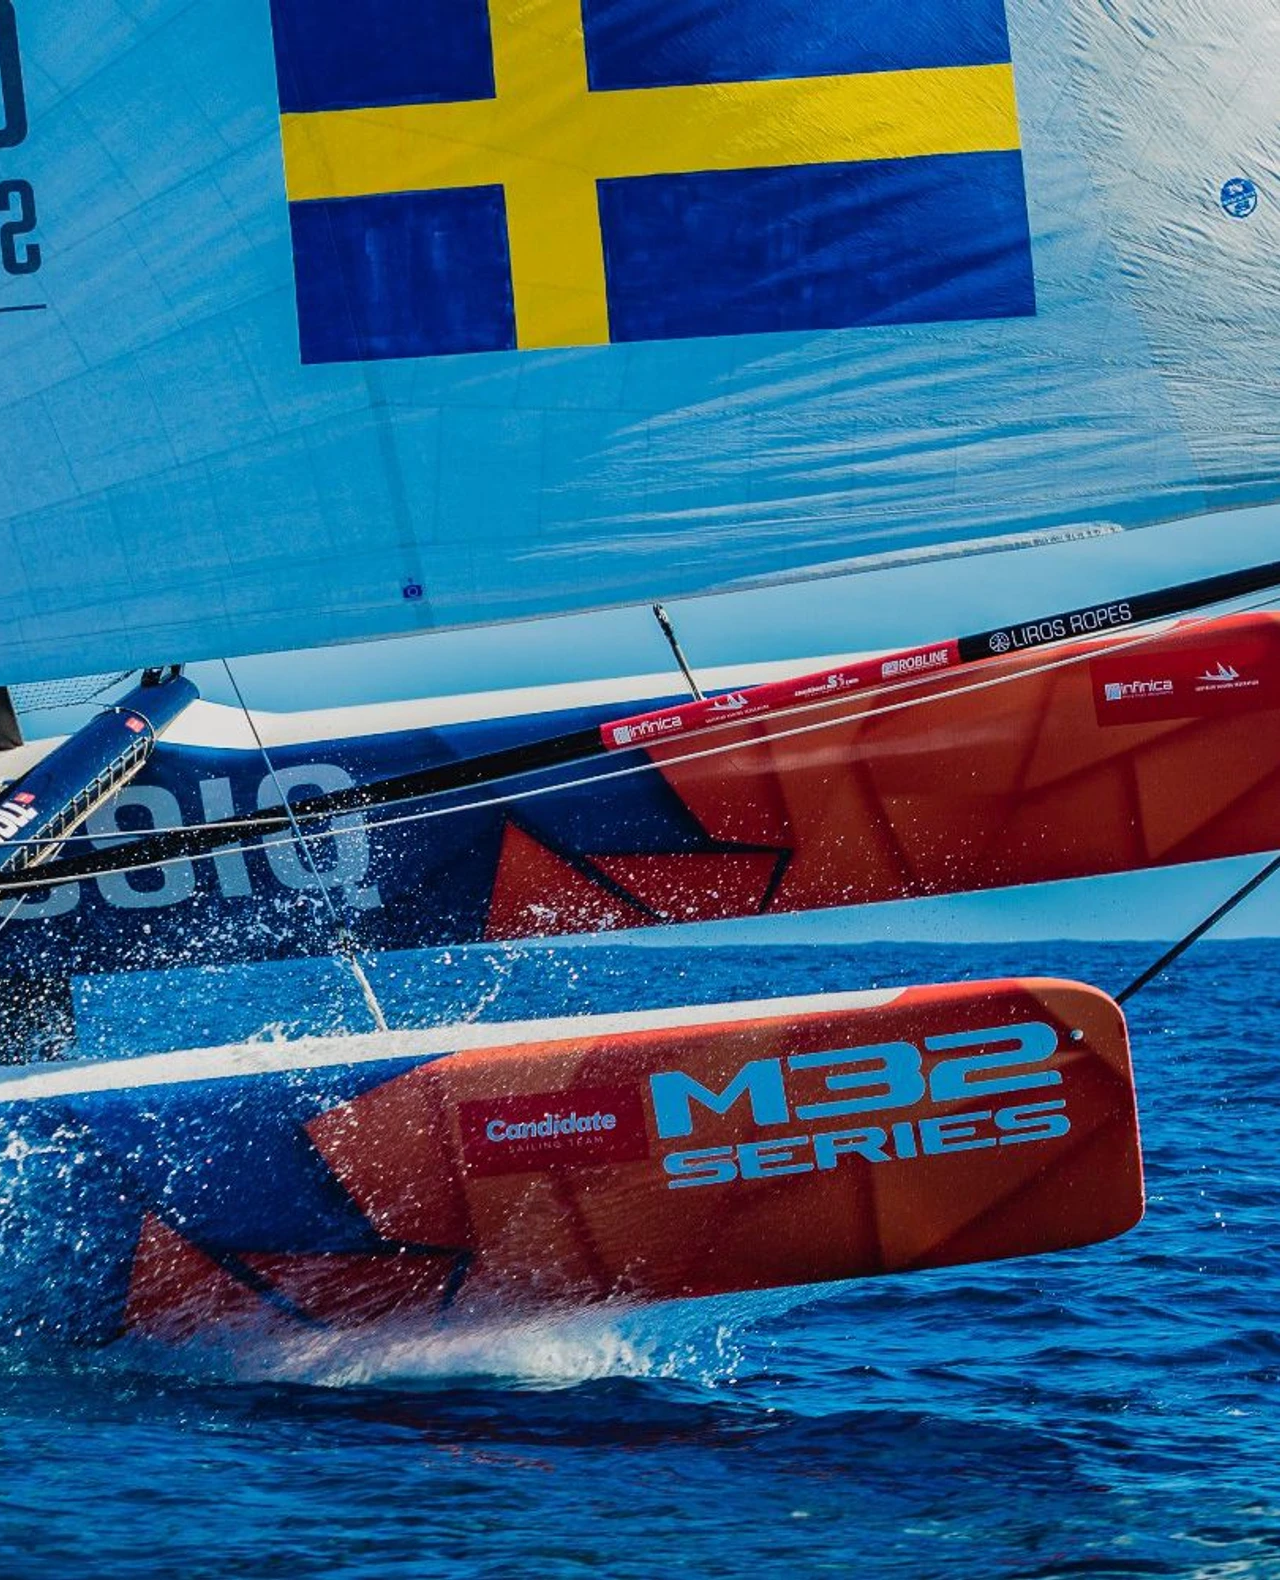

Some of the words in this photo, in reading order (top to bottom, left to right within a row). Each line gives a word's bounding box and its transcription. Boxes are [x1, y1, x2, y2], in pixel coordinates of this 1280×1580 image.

[1011, 618, 1067, 648] LIROS
[1069, 602, 1133, 634] ROPES
[898, 648, 949, 671] ROBLINE
[649, 1020, 1064, 1139] M32
[485, 1110, 617, 1142] Candidate
[663, 1098, 1072, 1190] SERIES
